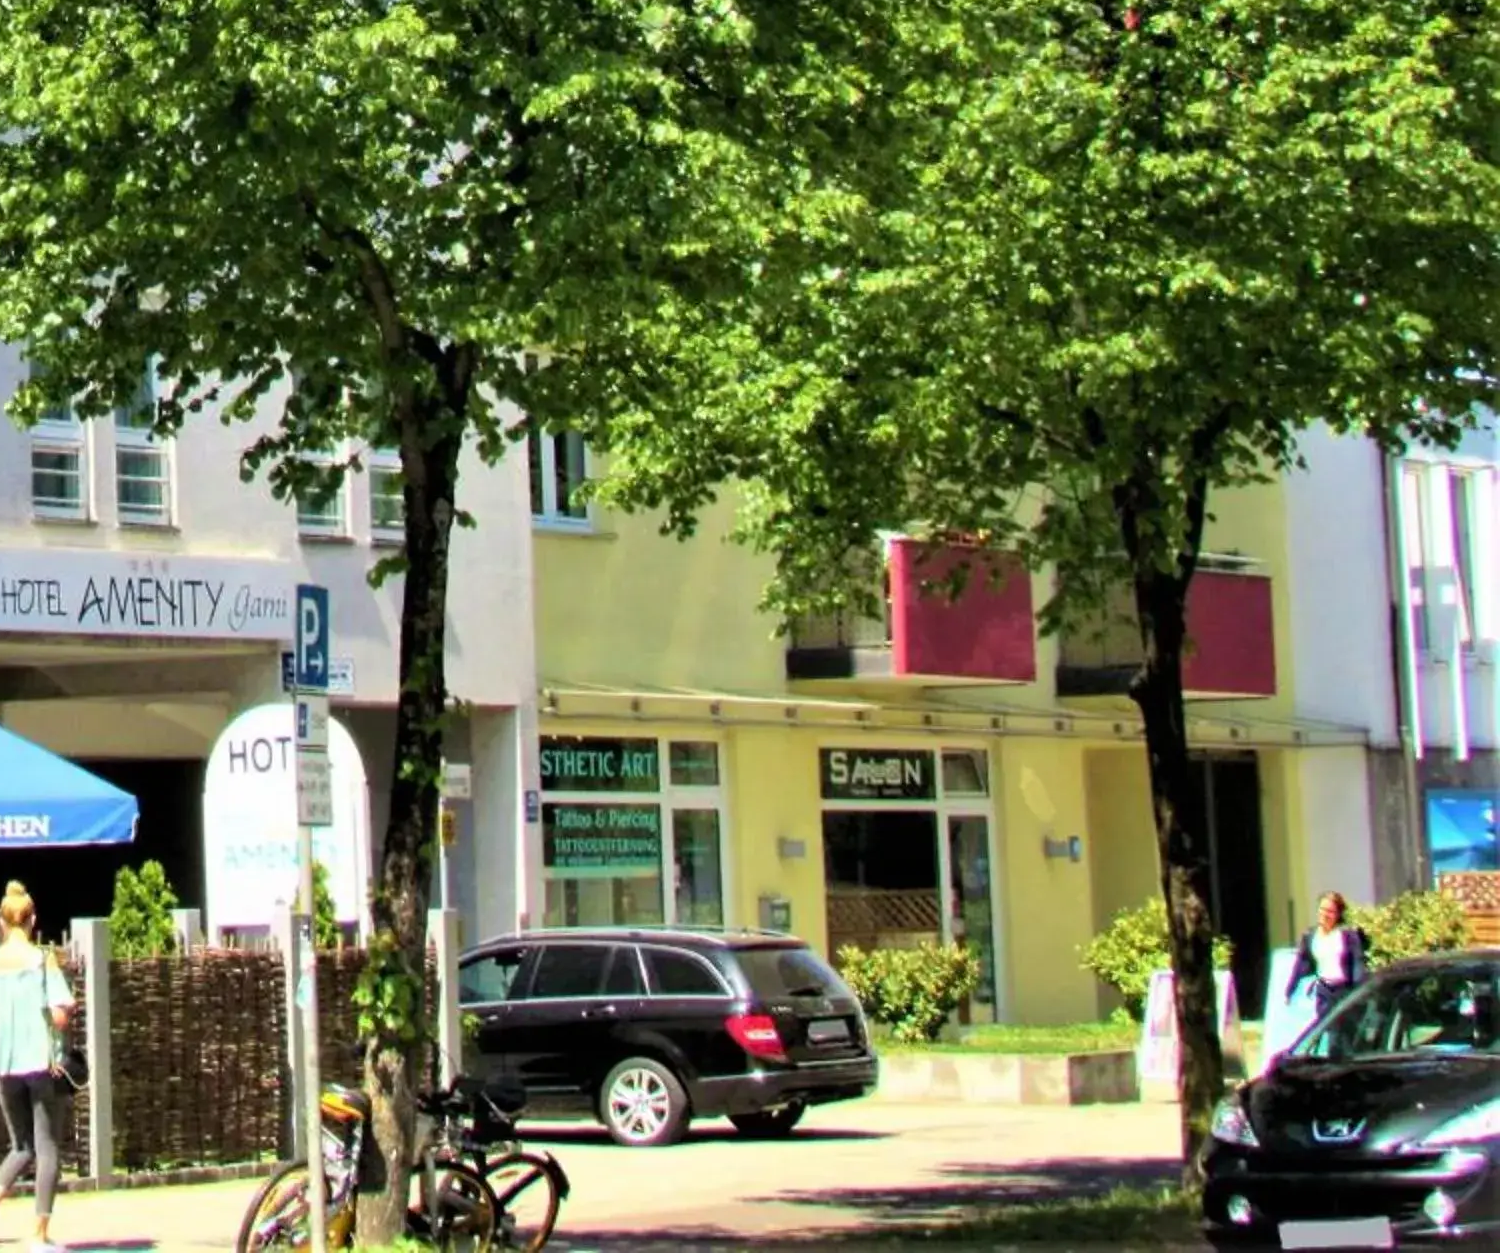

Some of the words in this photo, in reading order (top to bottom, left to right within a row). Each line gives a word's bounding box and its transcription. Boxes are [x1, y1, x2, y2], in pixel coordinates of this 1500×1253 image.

[1, 577, 68, 616] HOTEL
[78, 576, 225, 627] AMENITY
[301, 597, 321, 674] P
[228, 737, 293, 774] HOT
[620, 751, 656, 777] ART
